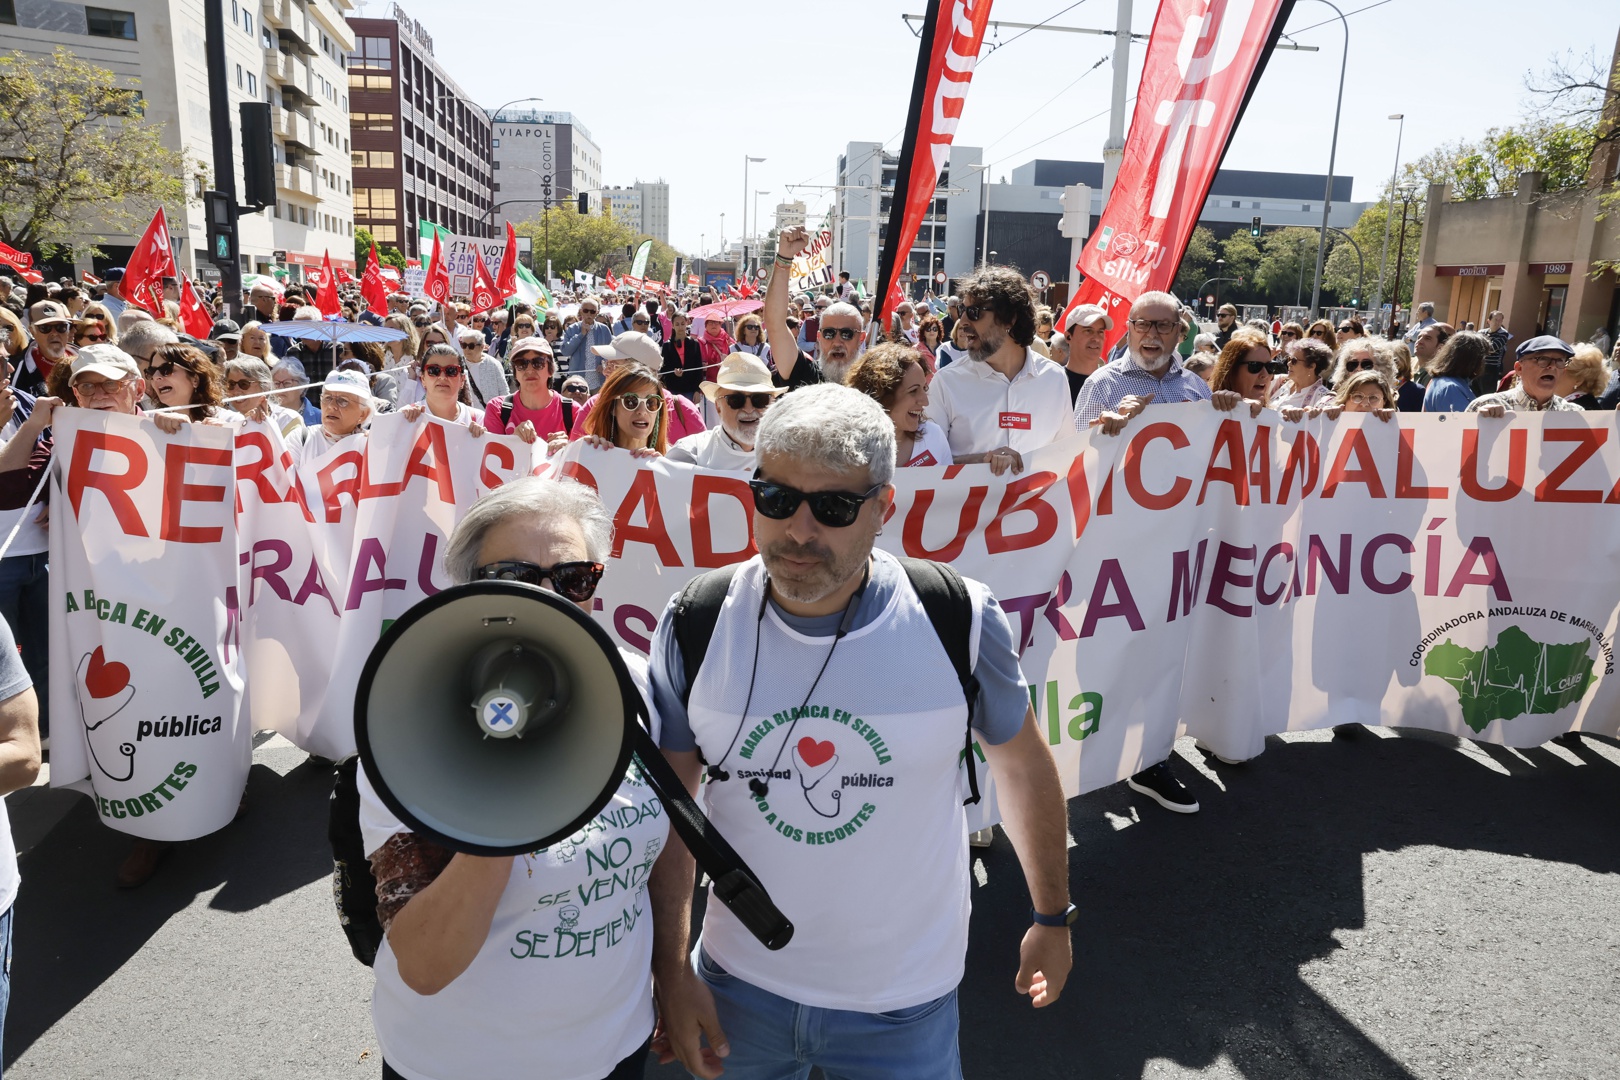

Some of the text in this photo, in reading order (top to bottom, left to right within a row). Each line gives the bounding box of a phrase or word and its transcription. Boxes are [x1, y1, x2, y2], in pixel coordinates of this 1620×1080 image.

[499, 128, 551, 138] VIAPOL
[540, 141, 552, 210] rcelo.com
[450, 241, 505, 257] 17M VOT
[1458, 267, 1488, 276] PODIUM
[1543, 264, 1566, 274] 1989
[132, 608, 167, 637] EN
[163, 627, 221, 699] SEVILLA
[1409, 610, 1485, 667] COORDINADORA
[1488, 606, 1547, 618] ANDALUZA
[1550, 610, 1568, 623] DE
[1595, 632, 1615, 675] BLANCAS
[137, 715, 222, 742] pública
[739, 705, 892, 766] MAREA BLANCA EN SEVILLA
[737, 769, 791, 780] sanidad
[841, 773, 894, 789] pública
[765, 812, 777, 825] A
[775, 820, 803, 843] LOS
[806, 802, 877, 845] RECORTES
[585, 837, 632, 877] NO
[533, 890, 571, 912] SE
[510, 929, 550, 960] SE
